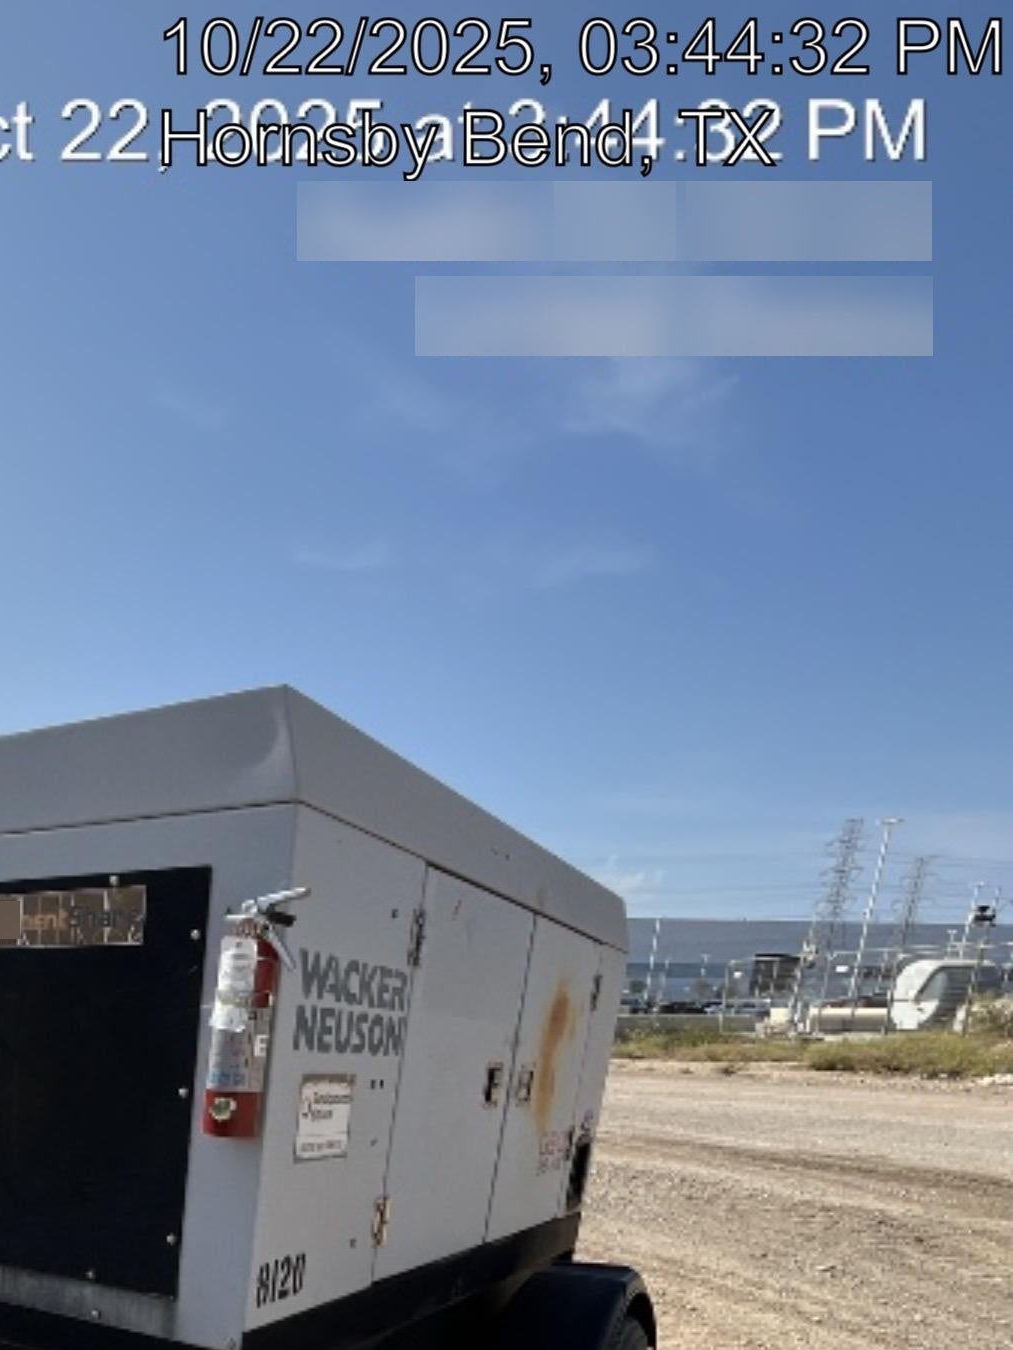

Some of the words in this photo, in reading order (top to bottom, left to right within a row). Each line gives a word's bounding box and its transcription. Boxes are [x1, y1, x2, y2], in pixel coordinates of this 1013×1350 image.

[300, 948, 408, 1012] WACKER
[292, 1005, 408, 1057] NEUSON
[256, 1252, 306, 1309] 8120
